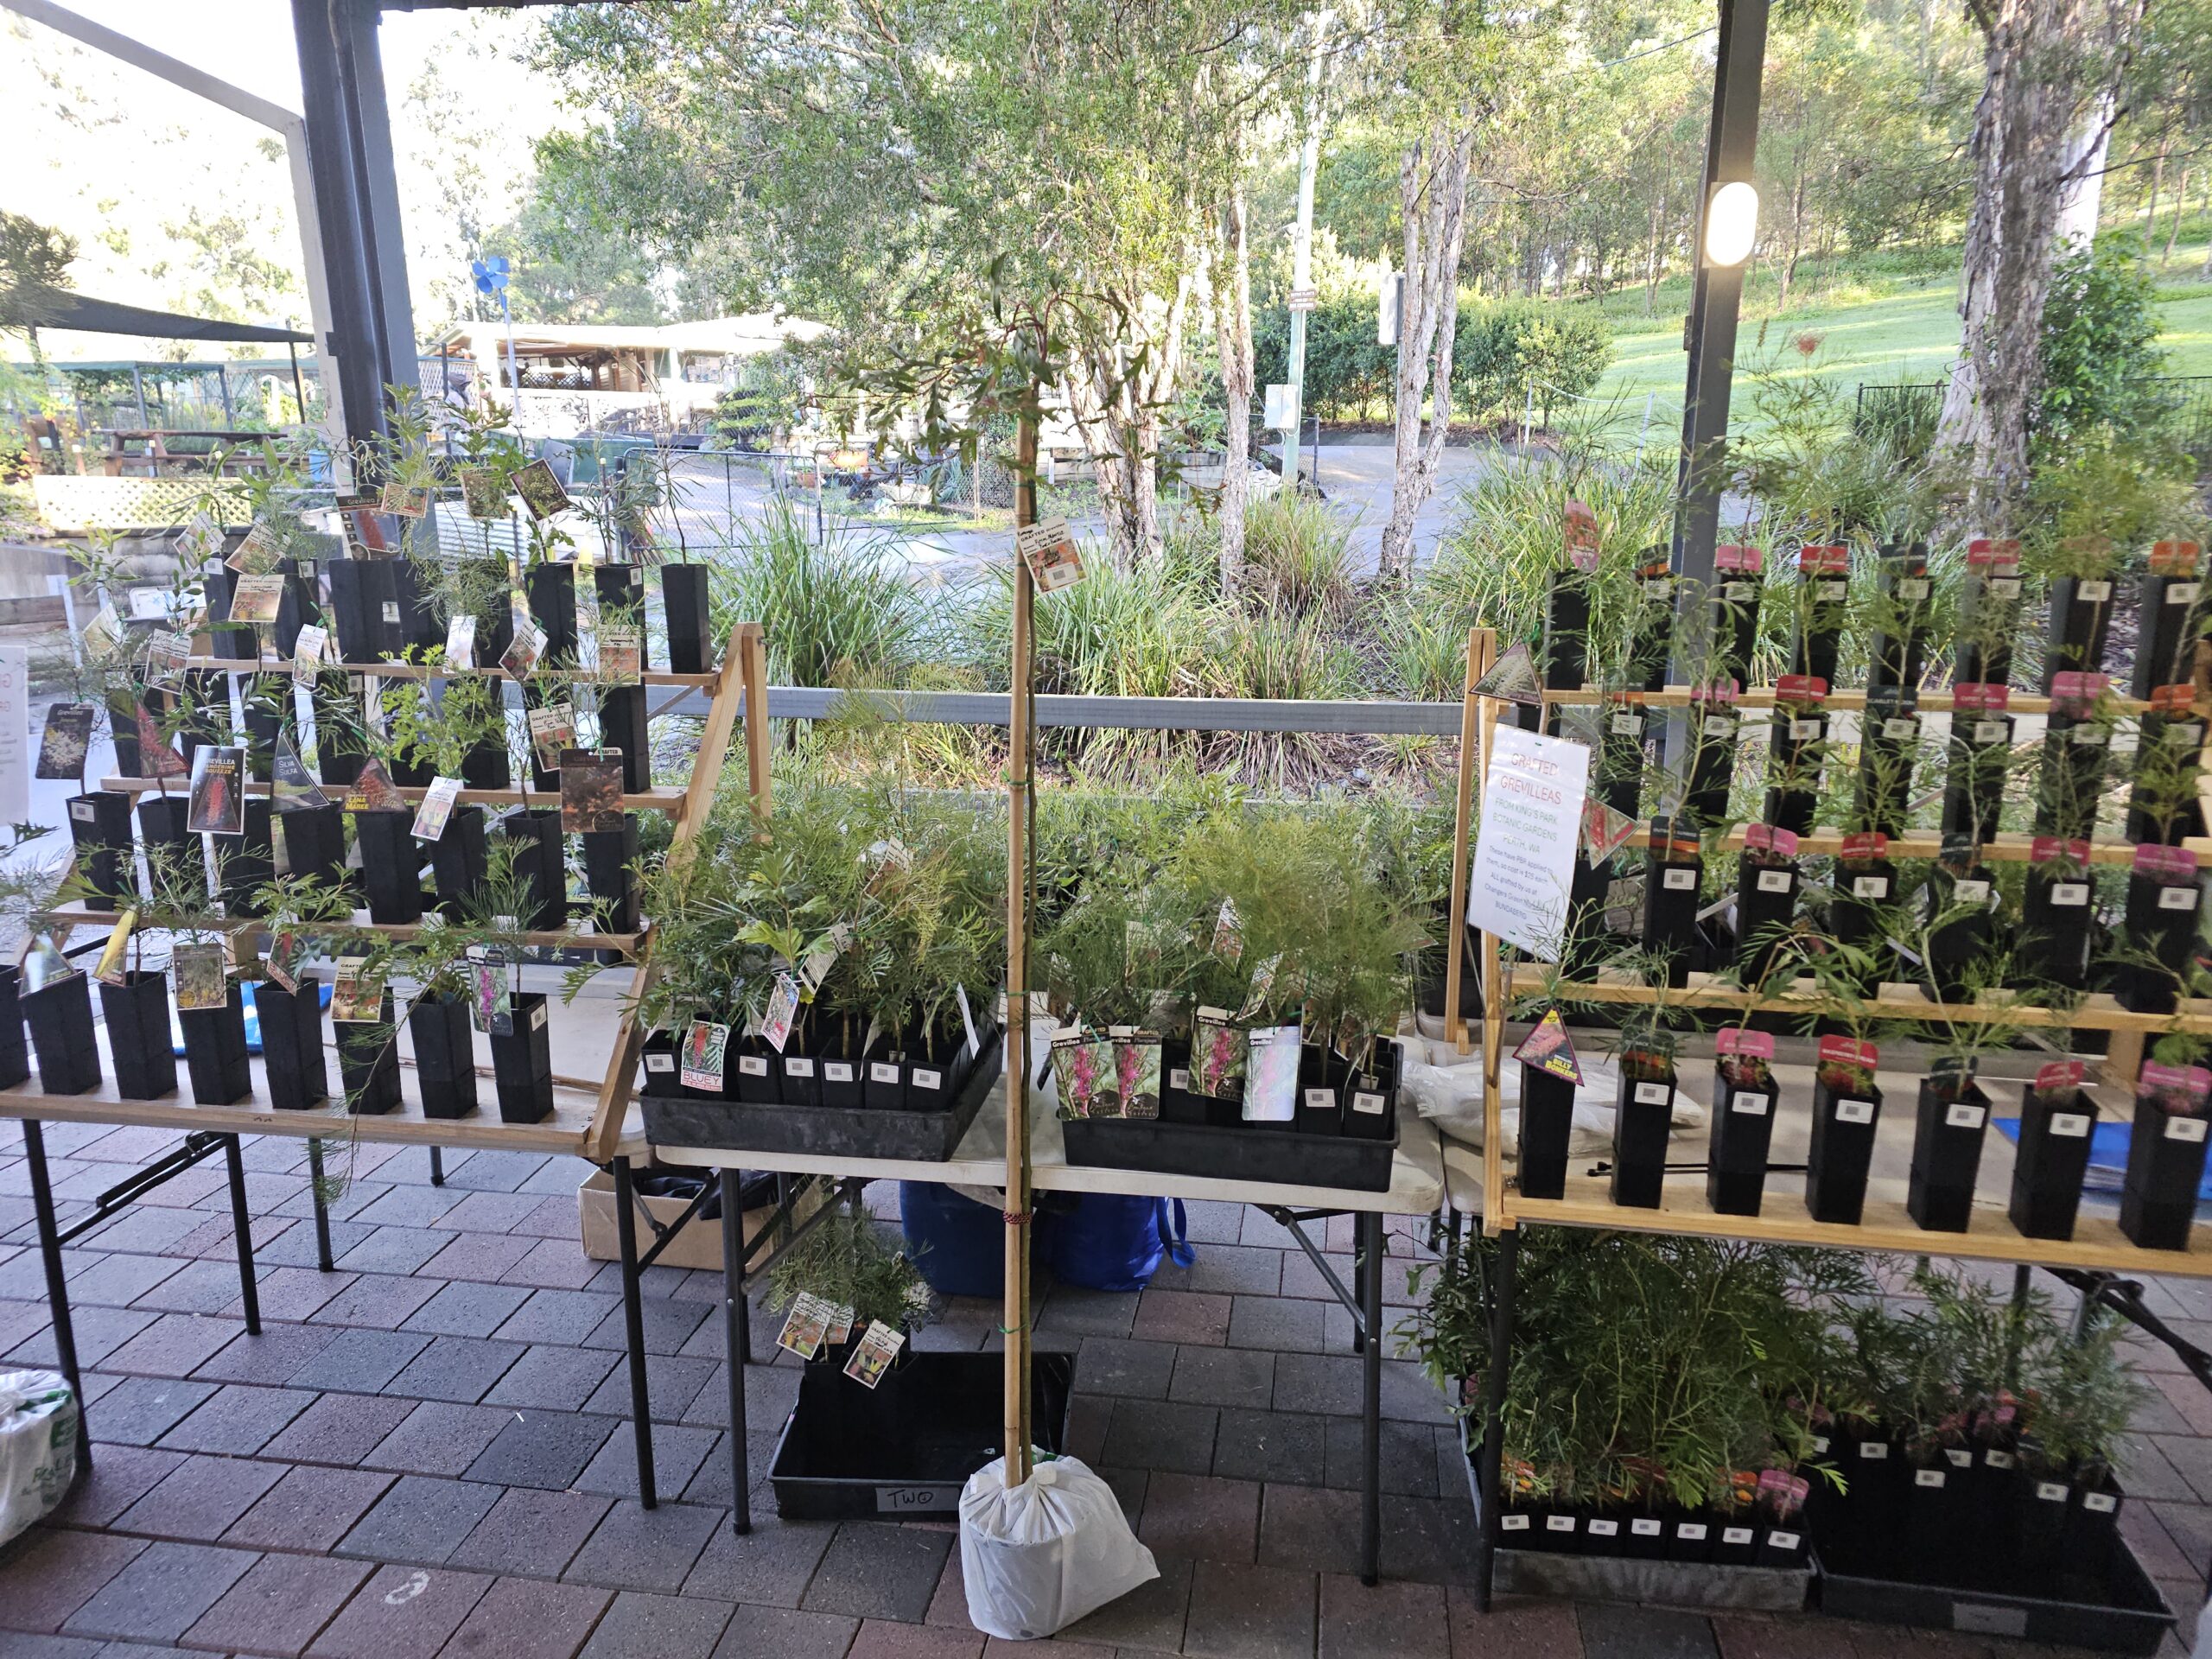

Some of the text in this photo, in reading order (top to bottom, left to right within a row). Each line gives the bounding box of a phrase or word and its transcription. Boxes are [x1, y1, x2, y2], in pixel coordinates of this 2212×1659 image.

[1511, 753, 1558, 776] GRAFTED
[1501, 776, 1561, 804] GREVILLEAS
[1495, 797, 1515, 810] FROM
[1539, 811, 1558, 825] PARK
[1493, 812, 1557, 842] BOTANIC GARDENS
[1529, 843, 1541, 854] WA
[1491, 872, 1499, 881] ALL
[1198, 1016, 1225, 1027] Grevillea
[1052, 1039, 1080, 1048] Grevillea
[1545, 1059, 1578, 1080] BONKERS
[1553, 1058, 1572, 1071] BILLY
[683, 1071, 719, 1085] BLUEY
[887, 1489, 933, 1508] TWO
